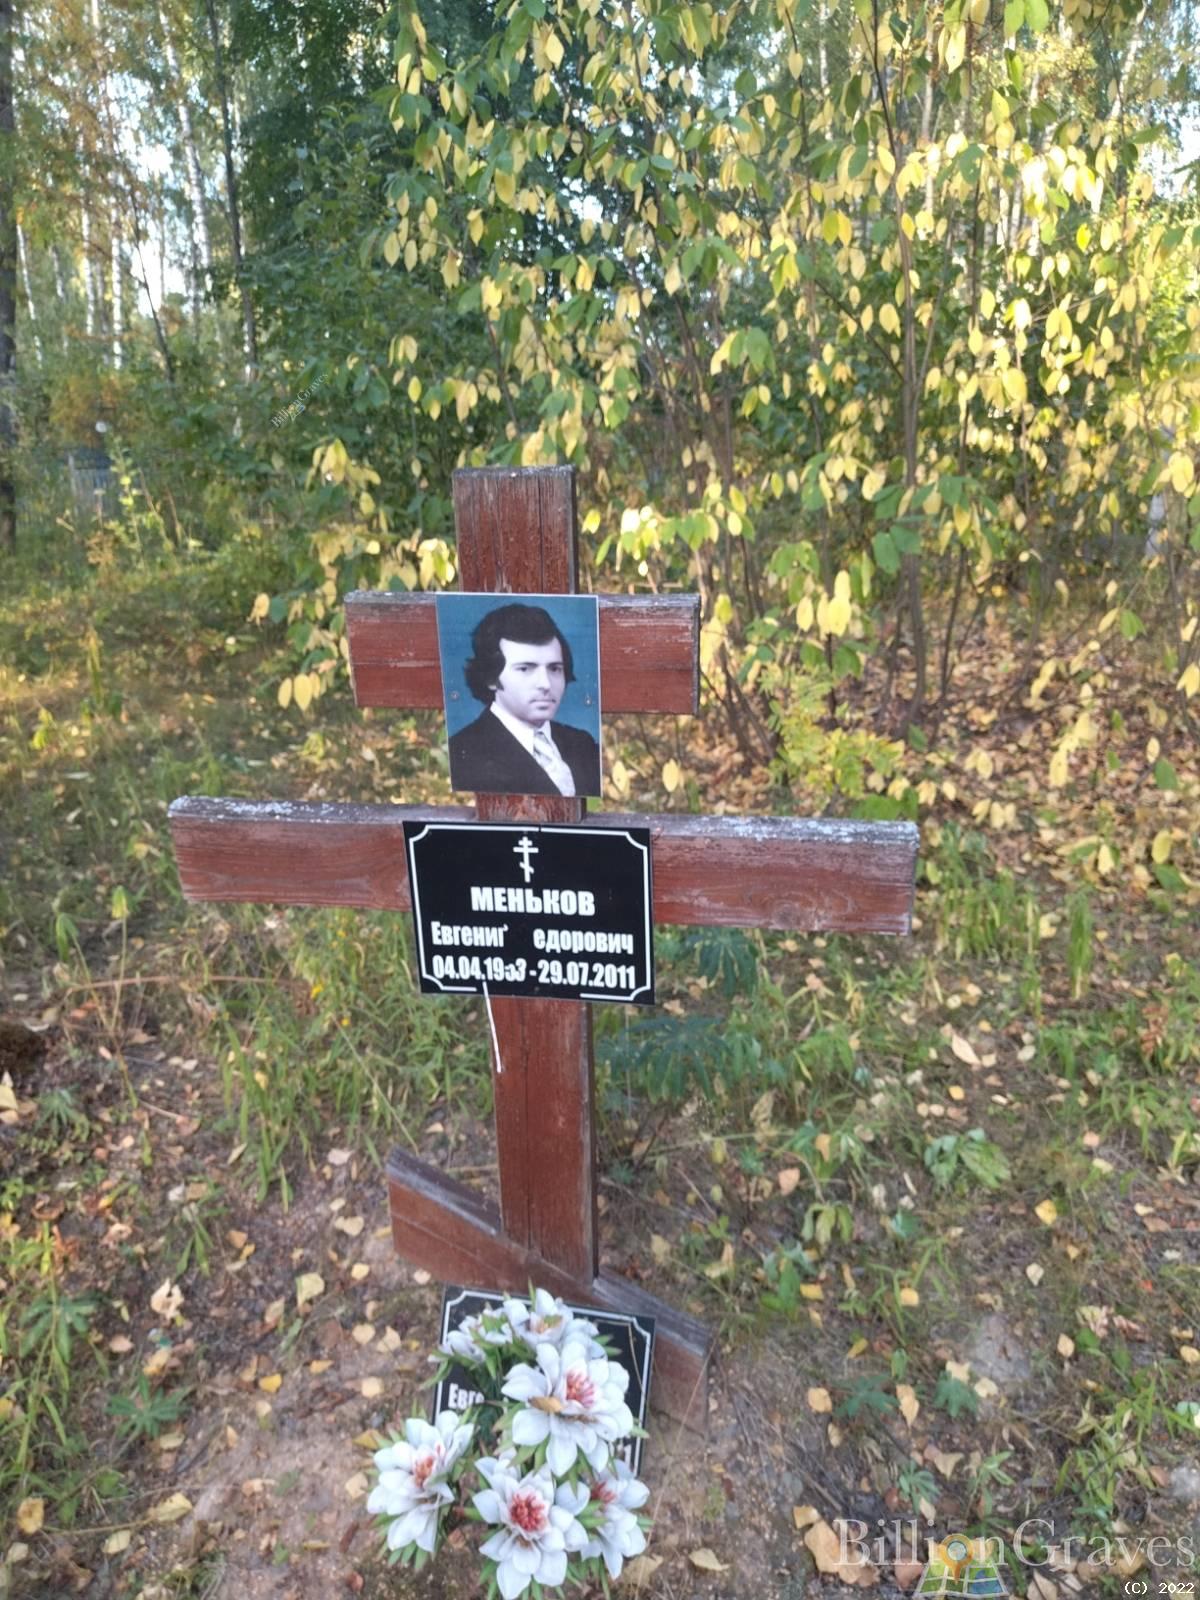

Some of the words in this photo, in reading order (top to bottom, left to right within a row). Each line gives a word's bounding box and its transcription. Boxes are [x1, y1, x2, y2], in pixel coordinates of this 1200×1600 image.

[470, 886, 595, 916] МЕНЬКОВ
[532, 928, 634, 955] едорович
[448, 1383, 485, 1410] Евге
